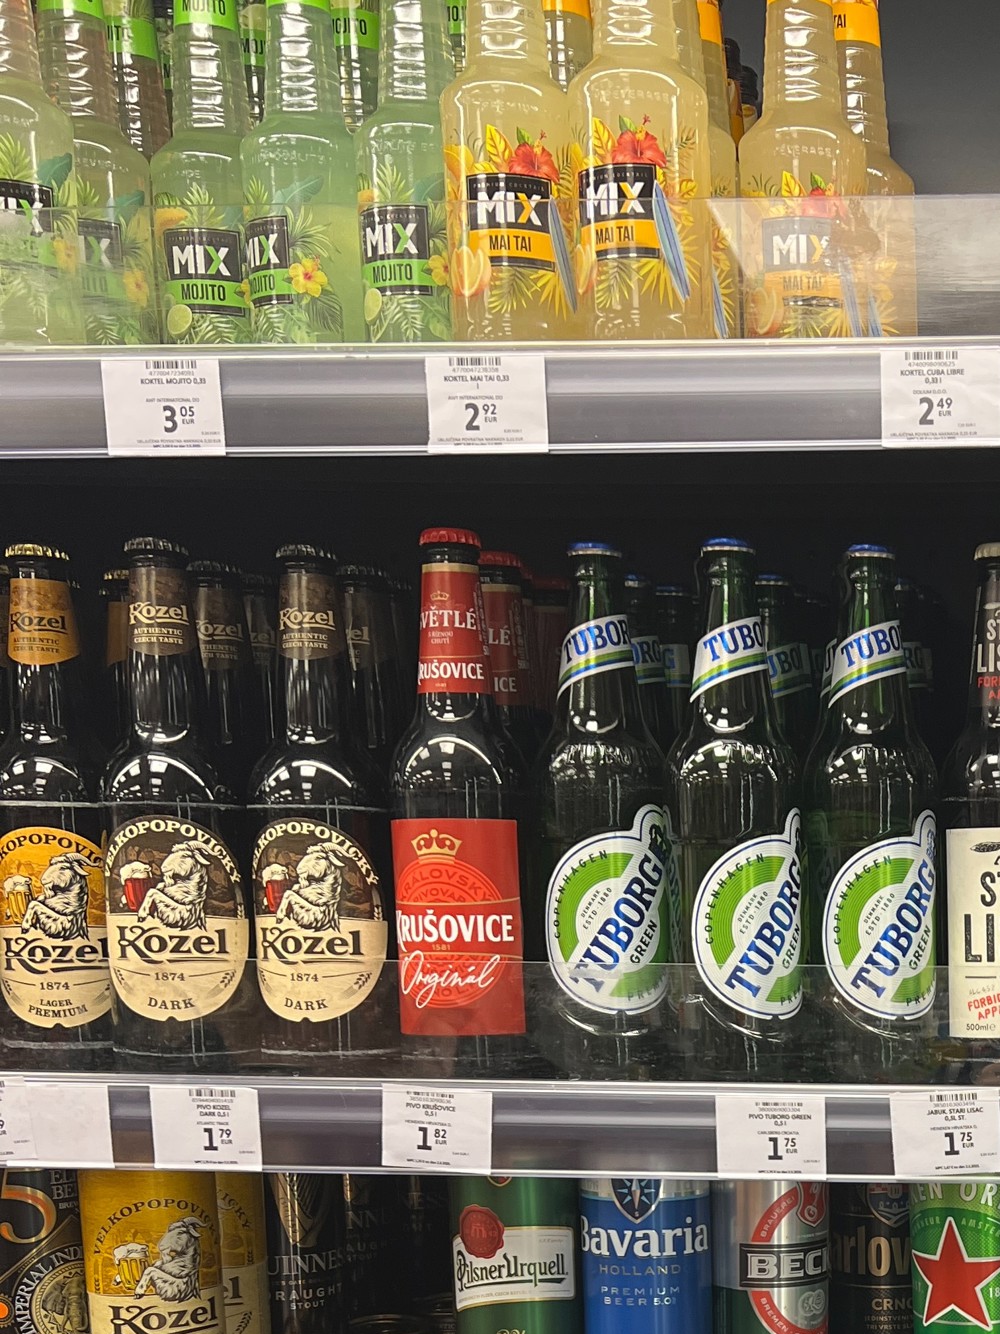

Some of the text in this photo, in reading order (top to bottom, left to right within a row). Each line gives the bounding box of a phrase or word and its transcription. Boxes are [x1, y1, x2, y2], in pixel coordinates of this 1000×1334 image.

[477, 192, 541, 225] MIX
[586, 181, 644, 214] MIX
[490, 235, 531, 252] MAI TAI
[596, 226, 633, 244] MAI TAI
[173, 245, 230, 275] MIX
[181, 283, 226, 301] MOJITO
[163, 405, 194, 432] 3 05
[465, 403, 496, 431] 2 92
[919, 397, 952, 425] 2 49
[129, 602, 189, 625] Kozel
[554, 850, 608, 938] COPENHAGEN
[851, 859, 935, 998] TUBORG
[118, 926, 229, 964] Kozel
[909, 925, 931, 971] GREEN
[155, 972, 185, 981] 1874
[401, 951, 500, 1008] Originál
[28, 1004, 87, 1018] PREMIUM
[40, 999, 72, 1007] LAGER
[148, 997, 195, 1010] DARK
[204, 1128, 231, 1151] 1 79
[944, 1132, 972, 1155] 1 75
[581, 1217, 709, 1258] Bavaria
[600, 1264, 681, 1274] HOLLAND
